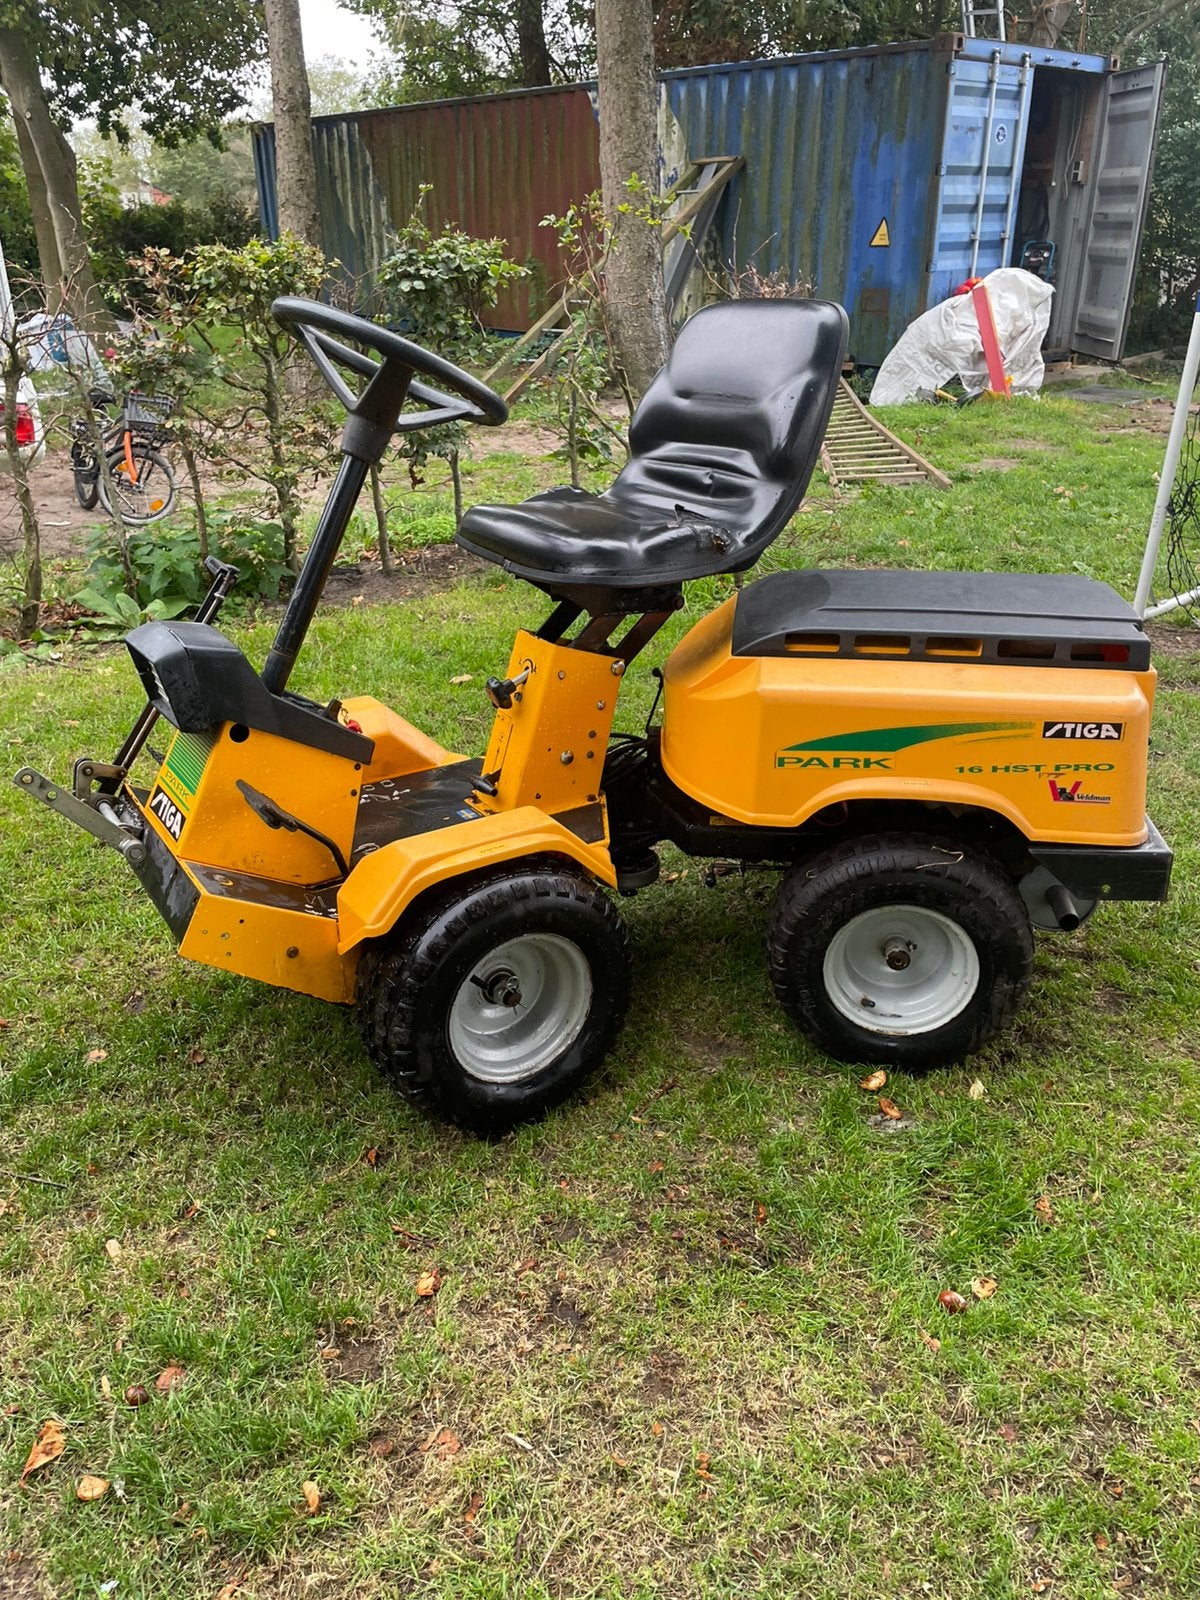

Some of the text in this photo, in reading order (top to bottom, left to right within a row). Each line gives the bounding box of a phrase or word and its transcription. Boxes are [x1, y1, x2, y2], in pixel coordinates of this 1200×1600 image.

[1045, 723, 1119, 739] STIGA
[777, 756, 893, 770] PARK
[955, 763, 1115, 774] 16 HST PRO
[165, 771, 191, 800] PARK
[1076, 793, 1112, 802] Veldman
[150, 791, 182, 840] STIGA
